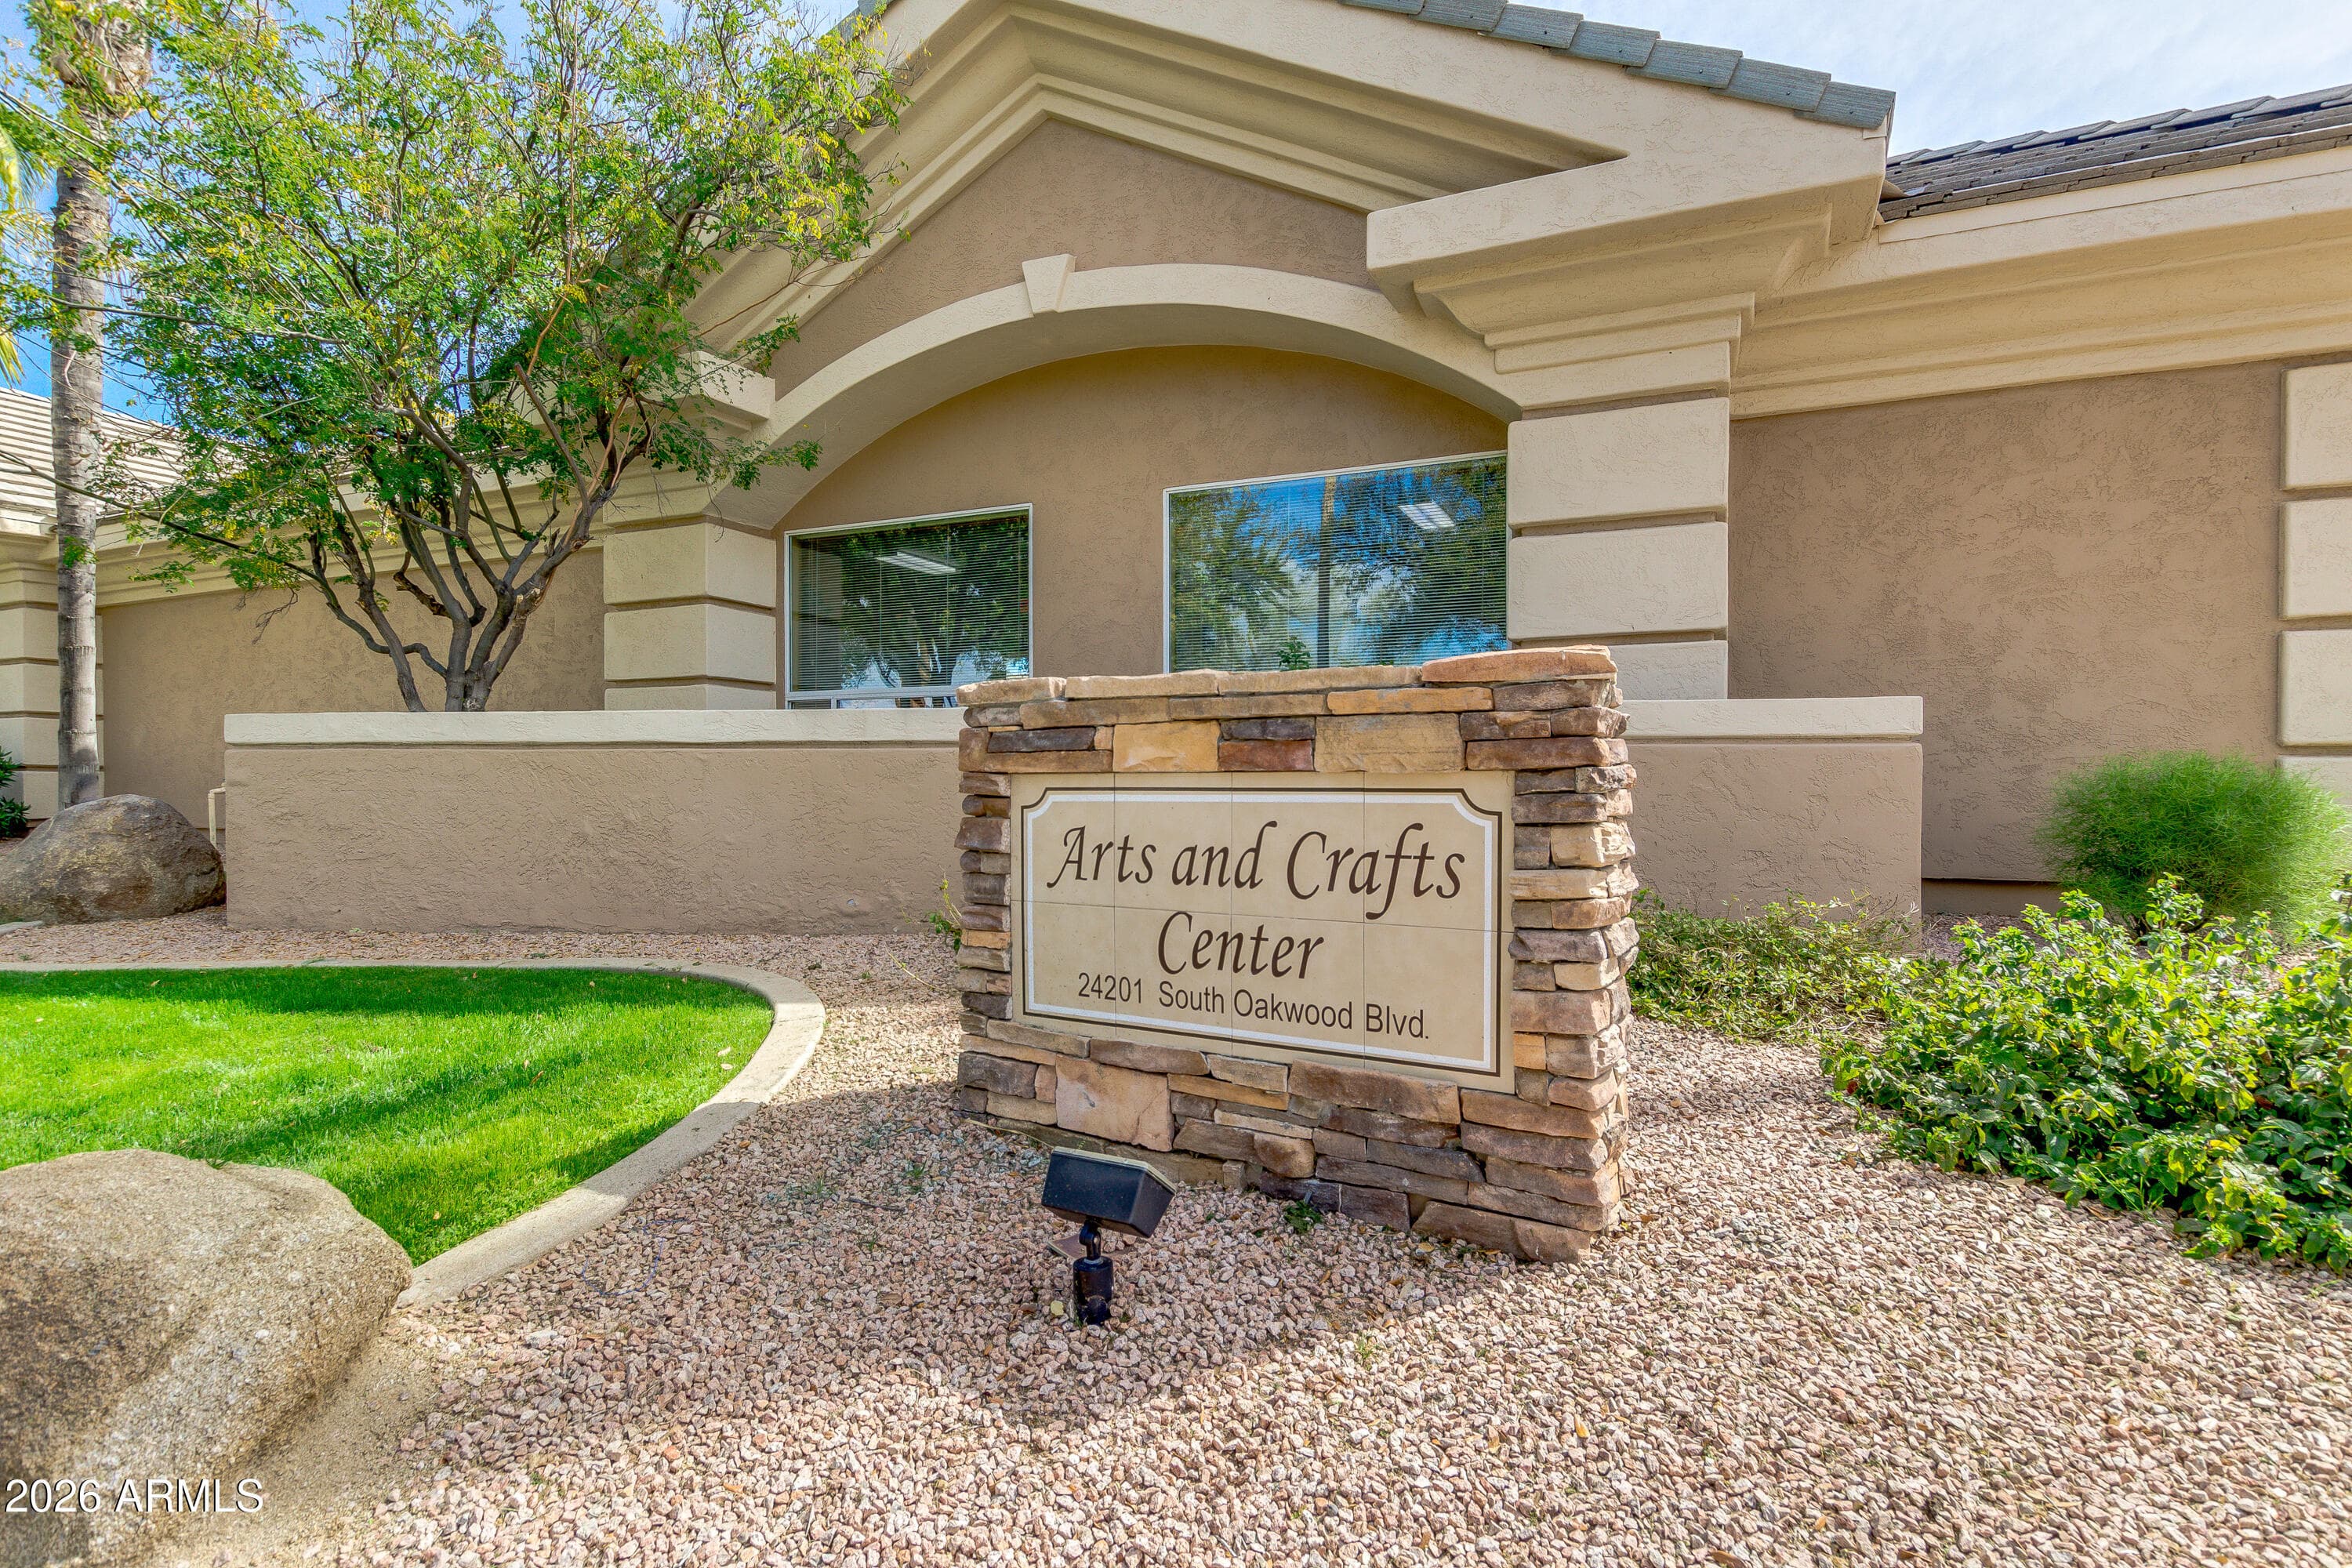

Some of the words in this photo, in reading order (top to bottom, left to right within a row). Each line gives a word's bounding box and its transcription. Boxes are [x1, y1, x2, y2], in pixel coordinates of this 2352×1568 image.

[1046, 825, 1156, 889] Arts
[1171, 820, 1278, 890] and
[1287, 822, 1465, 920] Crafts
[1158, 910, 1325, 979] Center
[1078, 972, 1142, 1004] 24201
[1158, 980, 1225, 1014] South
[1233, 989, 1352, 1029] Oakwood
[1366, 1003, 1429, 1039] Blvd.
